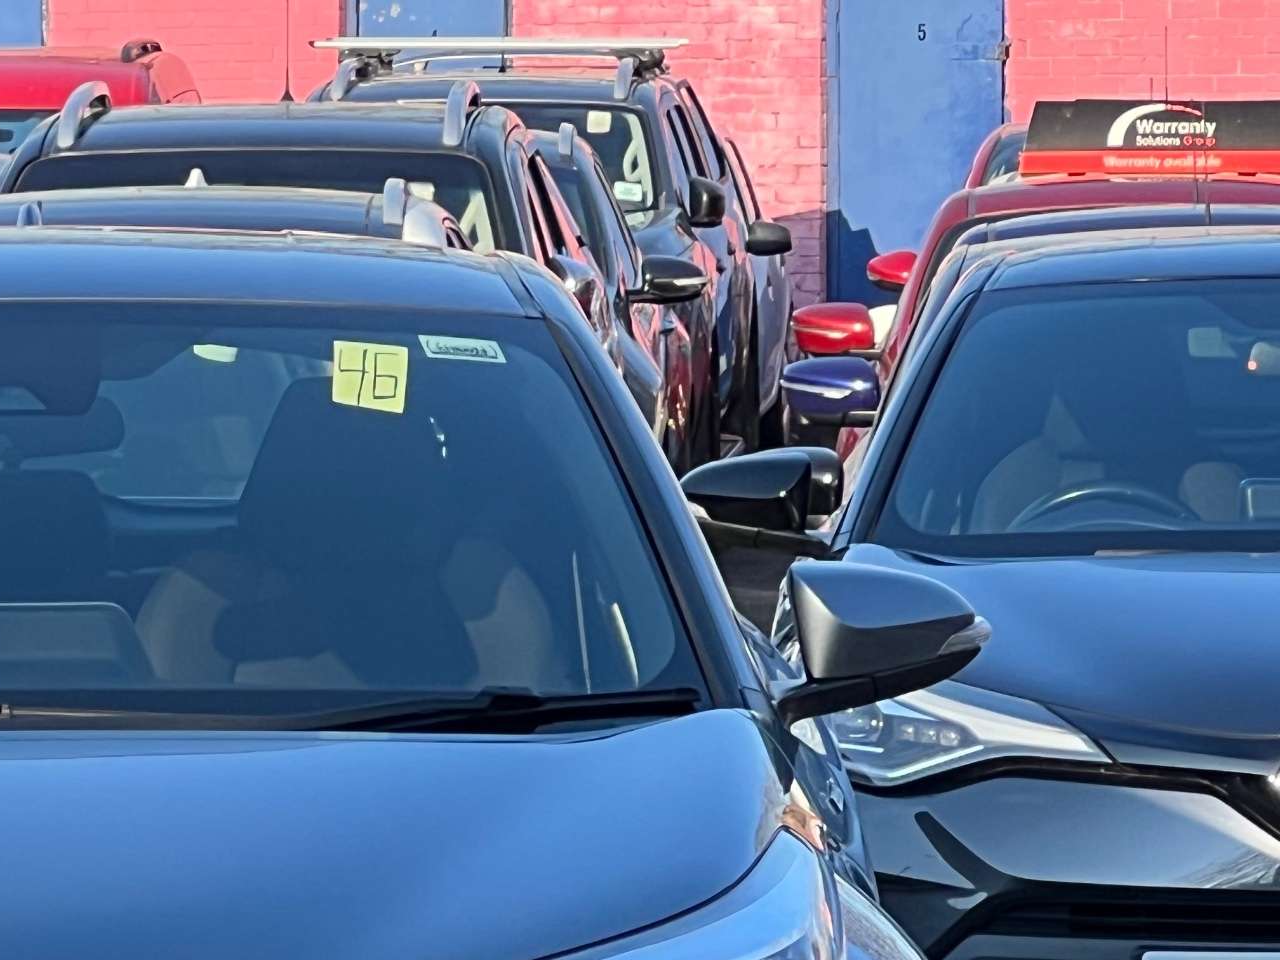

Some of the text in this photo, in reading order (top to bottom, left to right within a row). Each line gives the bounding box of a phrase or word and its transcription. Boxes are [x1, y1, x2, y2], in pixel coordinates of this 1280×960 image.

[917, 23, 927, 41] 5
[1136, 119, 1216, 137] Warranty
[1136, 135, 1180, 146] Solutions
[338, 348, 400, 406] 46
